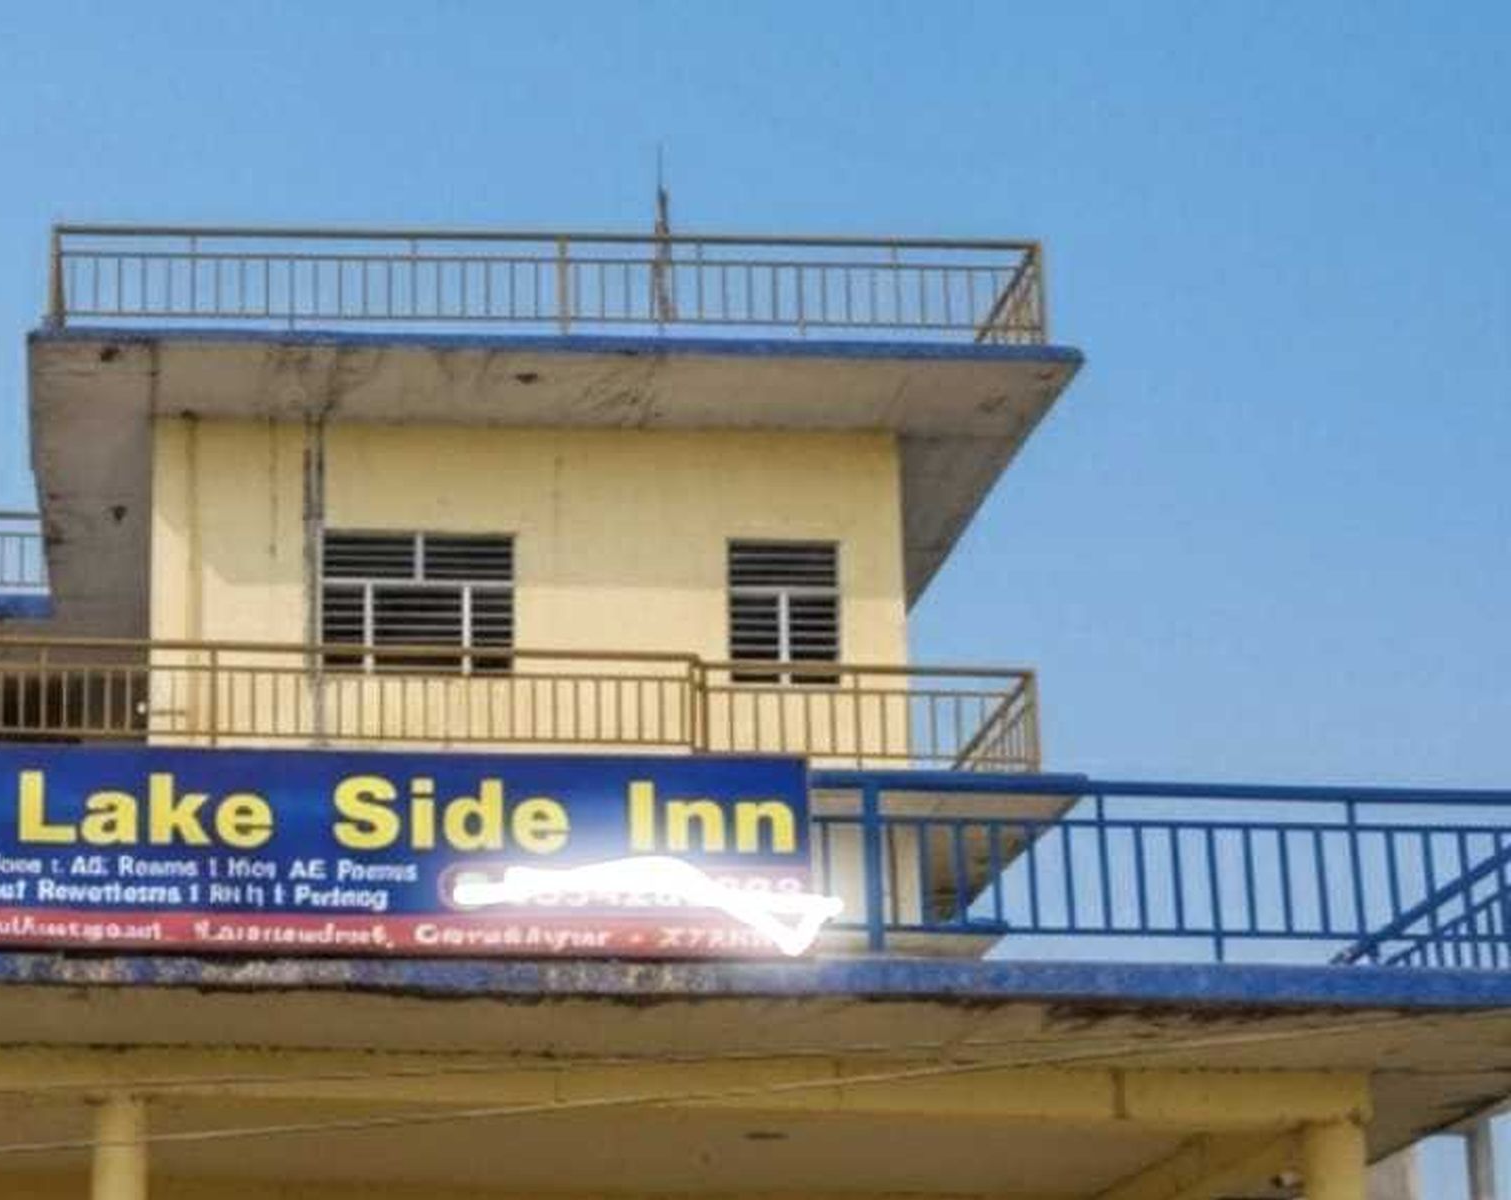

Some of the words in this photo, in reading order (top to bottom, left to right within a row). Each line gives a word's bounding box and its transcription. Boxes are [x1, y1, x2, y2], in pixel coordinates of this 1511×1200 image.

[18, 771, 273, 846] Lake
[333, 776, 569, 853] Side
[628, 780, 796, 853] Inn
